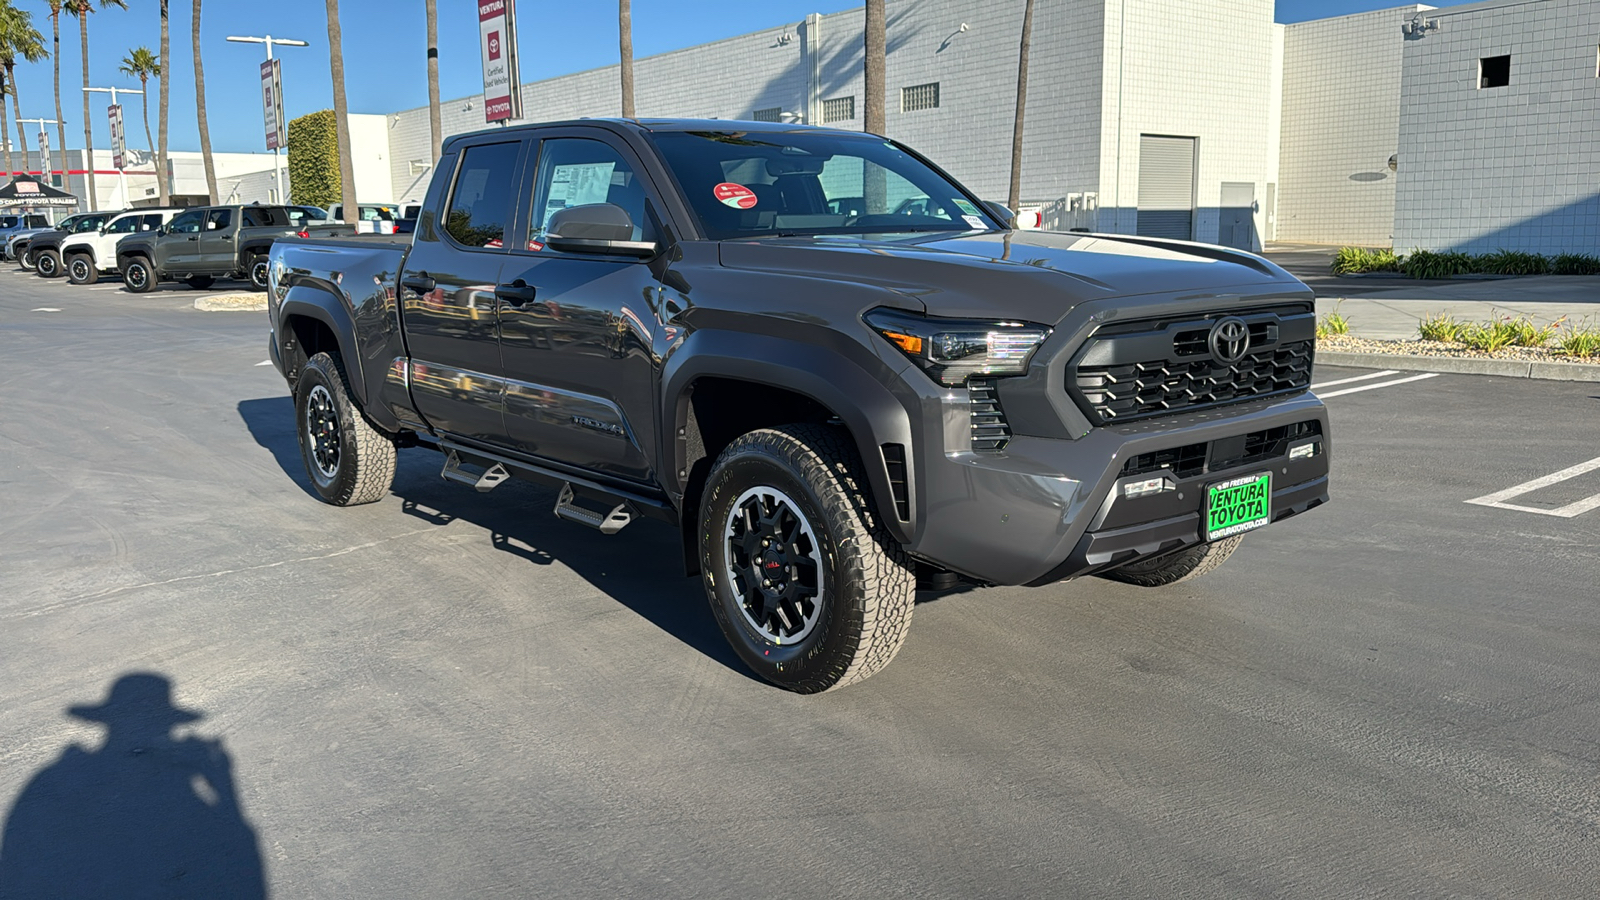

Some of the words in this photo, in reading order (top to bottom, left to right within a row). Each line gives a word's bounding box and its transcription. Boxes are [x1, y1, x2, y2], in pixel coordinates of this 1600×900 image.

[479, 0, 504, 15] VENTURA
[487, 65, 503, 76] Certified
[492, 102, 510, 113] TOYOTA
[572, 415, 624, 435] TACOMA
[1230, 476, 1256, 487] FREEWAY
[1209, 483, 1264, 509] VENTURA
[1210, 500, 1263, 527] TOYOTA
[1209, 517, 1268, 540] VENTURATOYOTA.COM
